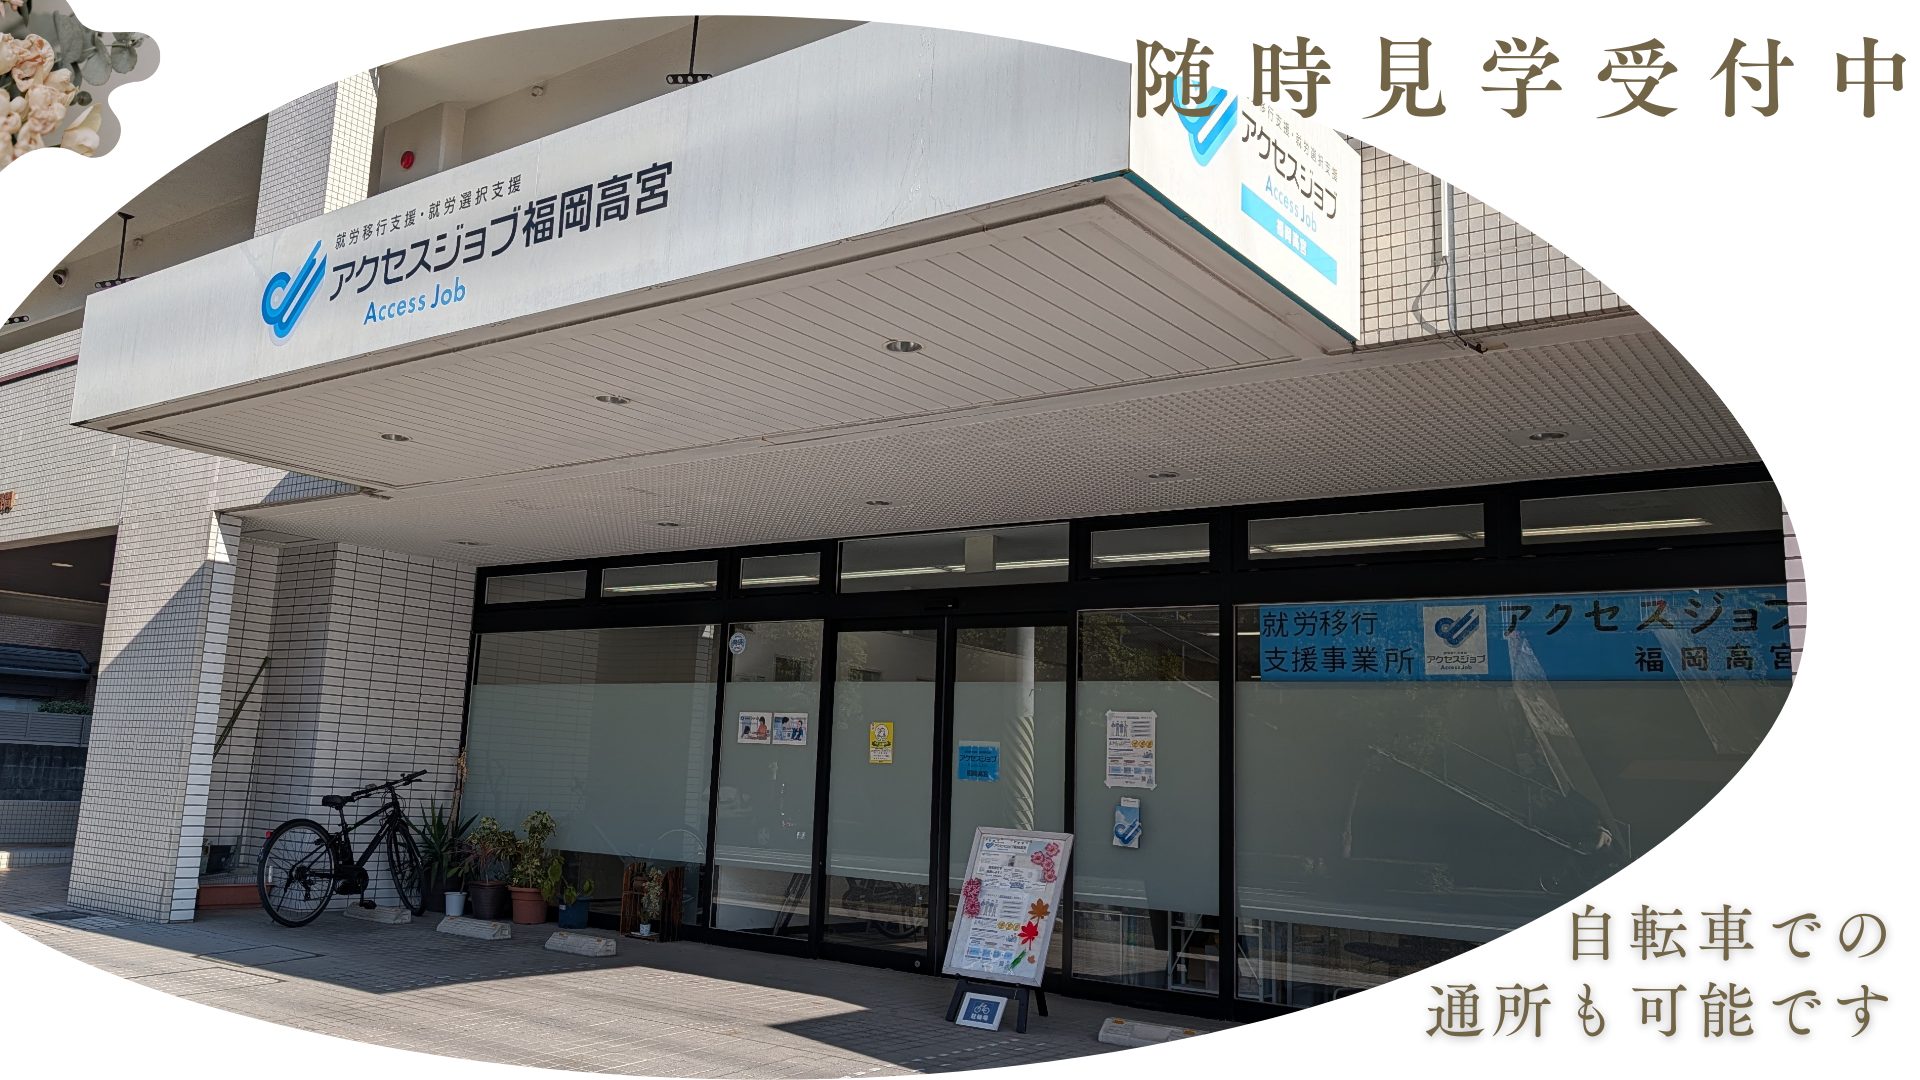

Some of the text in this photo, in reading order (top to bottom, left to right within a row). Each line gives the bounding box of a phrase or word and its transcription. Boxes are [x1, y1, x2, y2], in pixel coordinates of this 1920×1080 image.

[1241, 111, 1338, 219] アクセスジョブ
[335, 174, 522, 250] 就労移行支援・就労選択支援
[1265, 175, 1317, 233] Access Job
[330, 160, 673, 301] アクセスジョブ福岡高宮
[363, 277, 466, 325] Access Job
[1262, 609, 1378, 638] 就労移行
[1264, 645, 1415, 675] 支援事業所
[1427, 655, 1486, 664] アクセスジョブ
[1635, 642, 1792, 672] 福岡高宮
